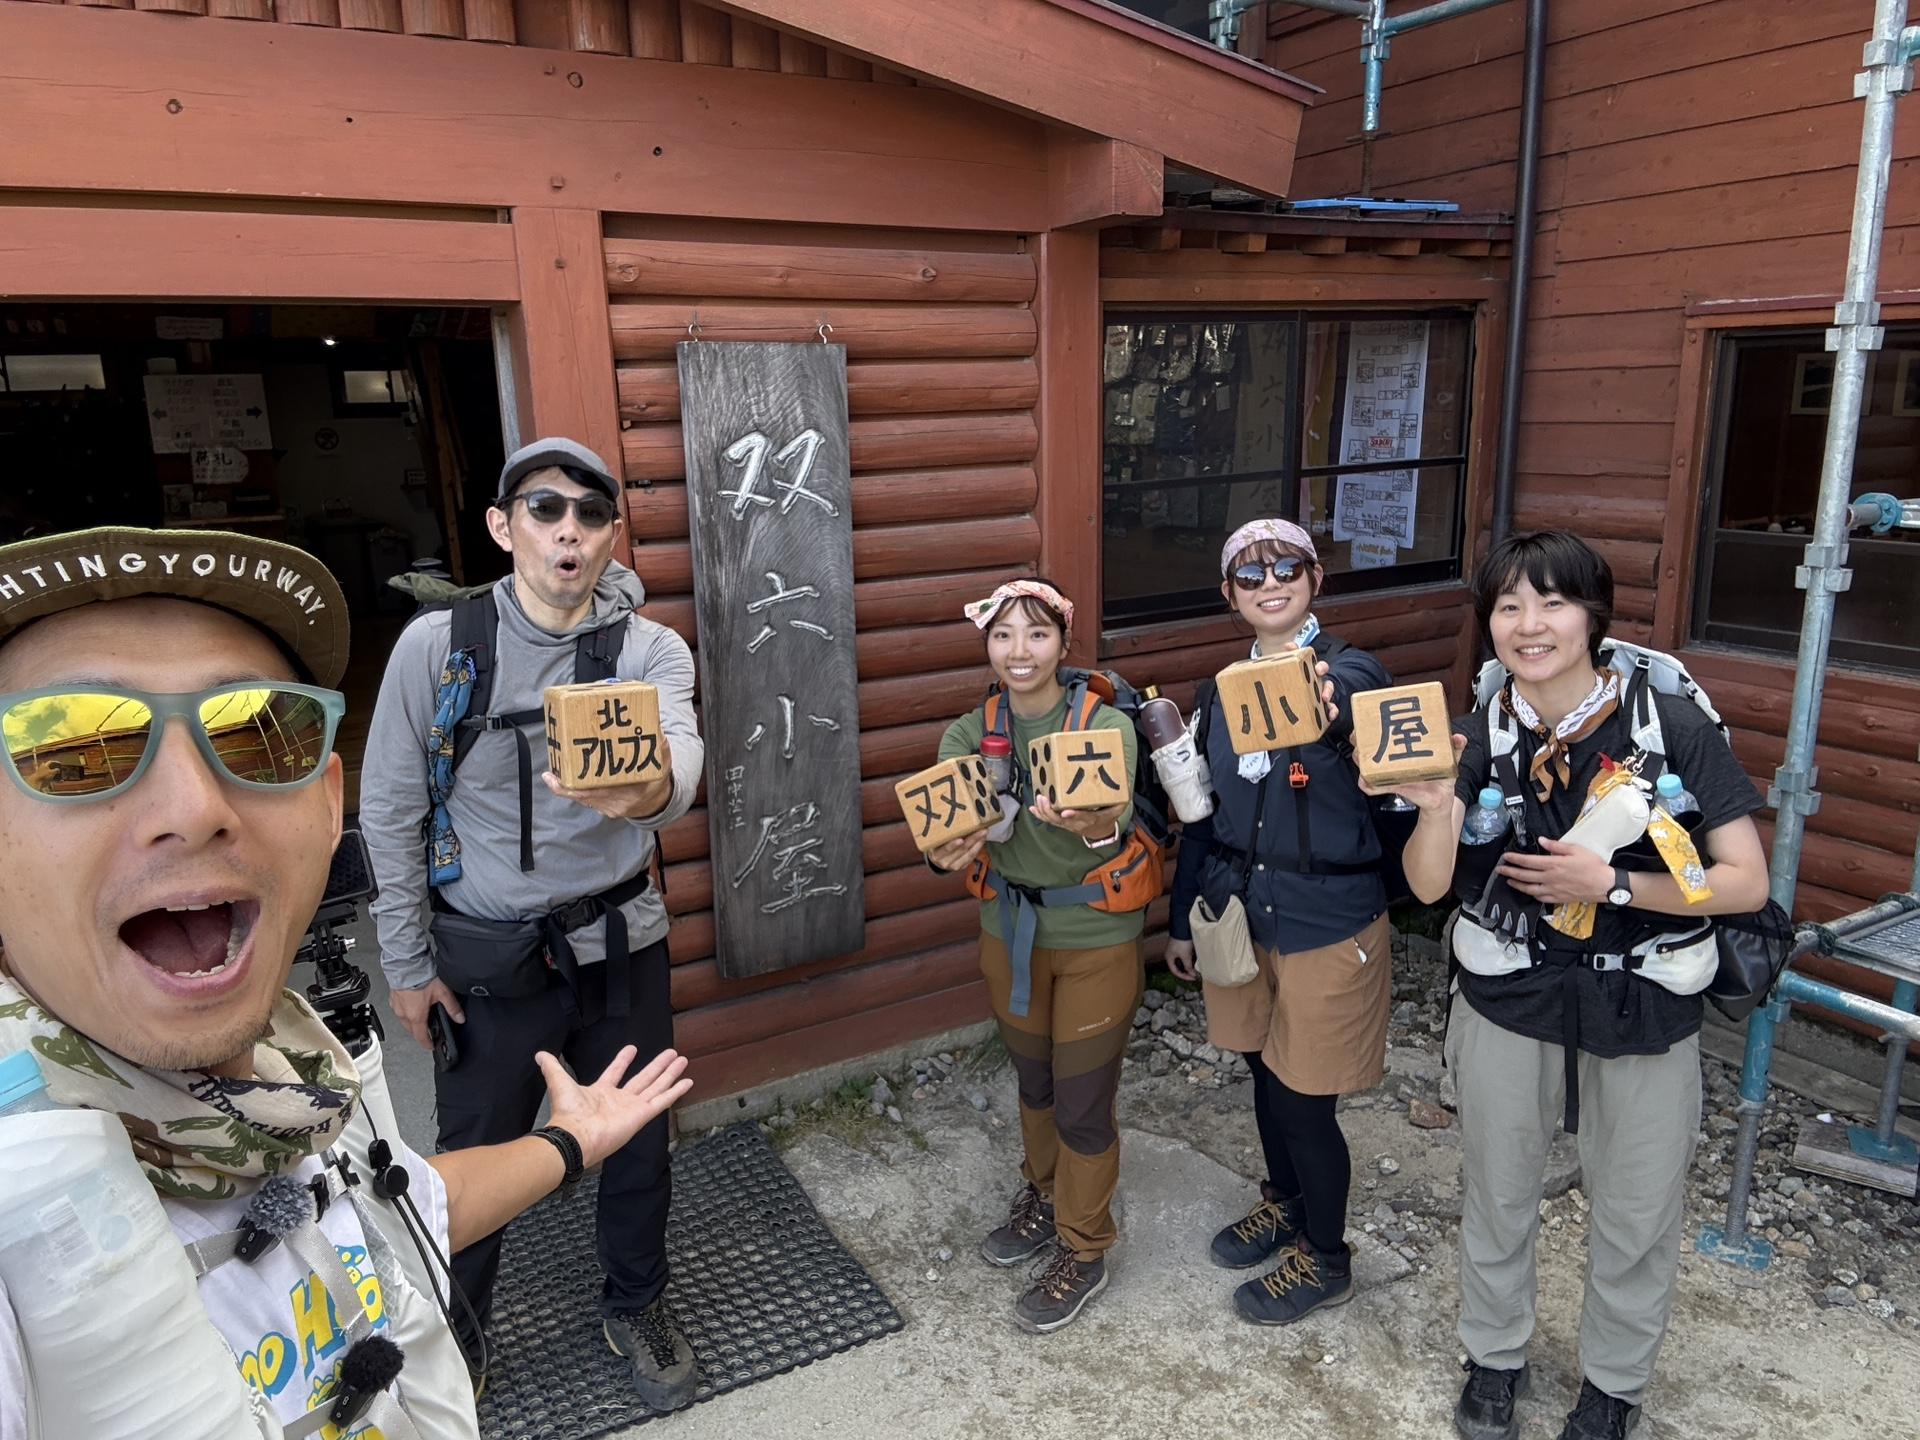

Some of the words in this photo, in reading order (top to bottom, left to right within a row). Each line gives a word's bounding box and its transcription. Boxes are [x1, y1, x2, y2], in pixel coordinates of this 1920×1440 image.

[717, 427, 848, 915] 双六小屋
[596, 698, 632, 731] 北
[1241, 680, 1299, 741] 小
[1372, 696, 1434, 763] 屋
[572, 727, 662, 780] アルプス
[1066, 741, 1120, 794] 六
[904, 774, 967, 838] 双
